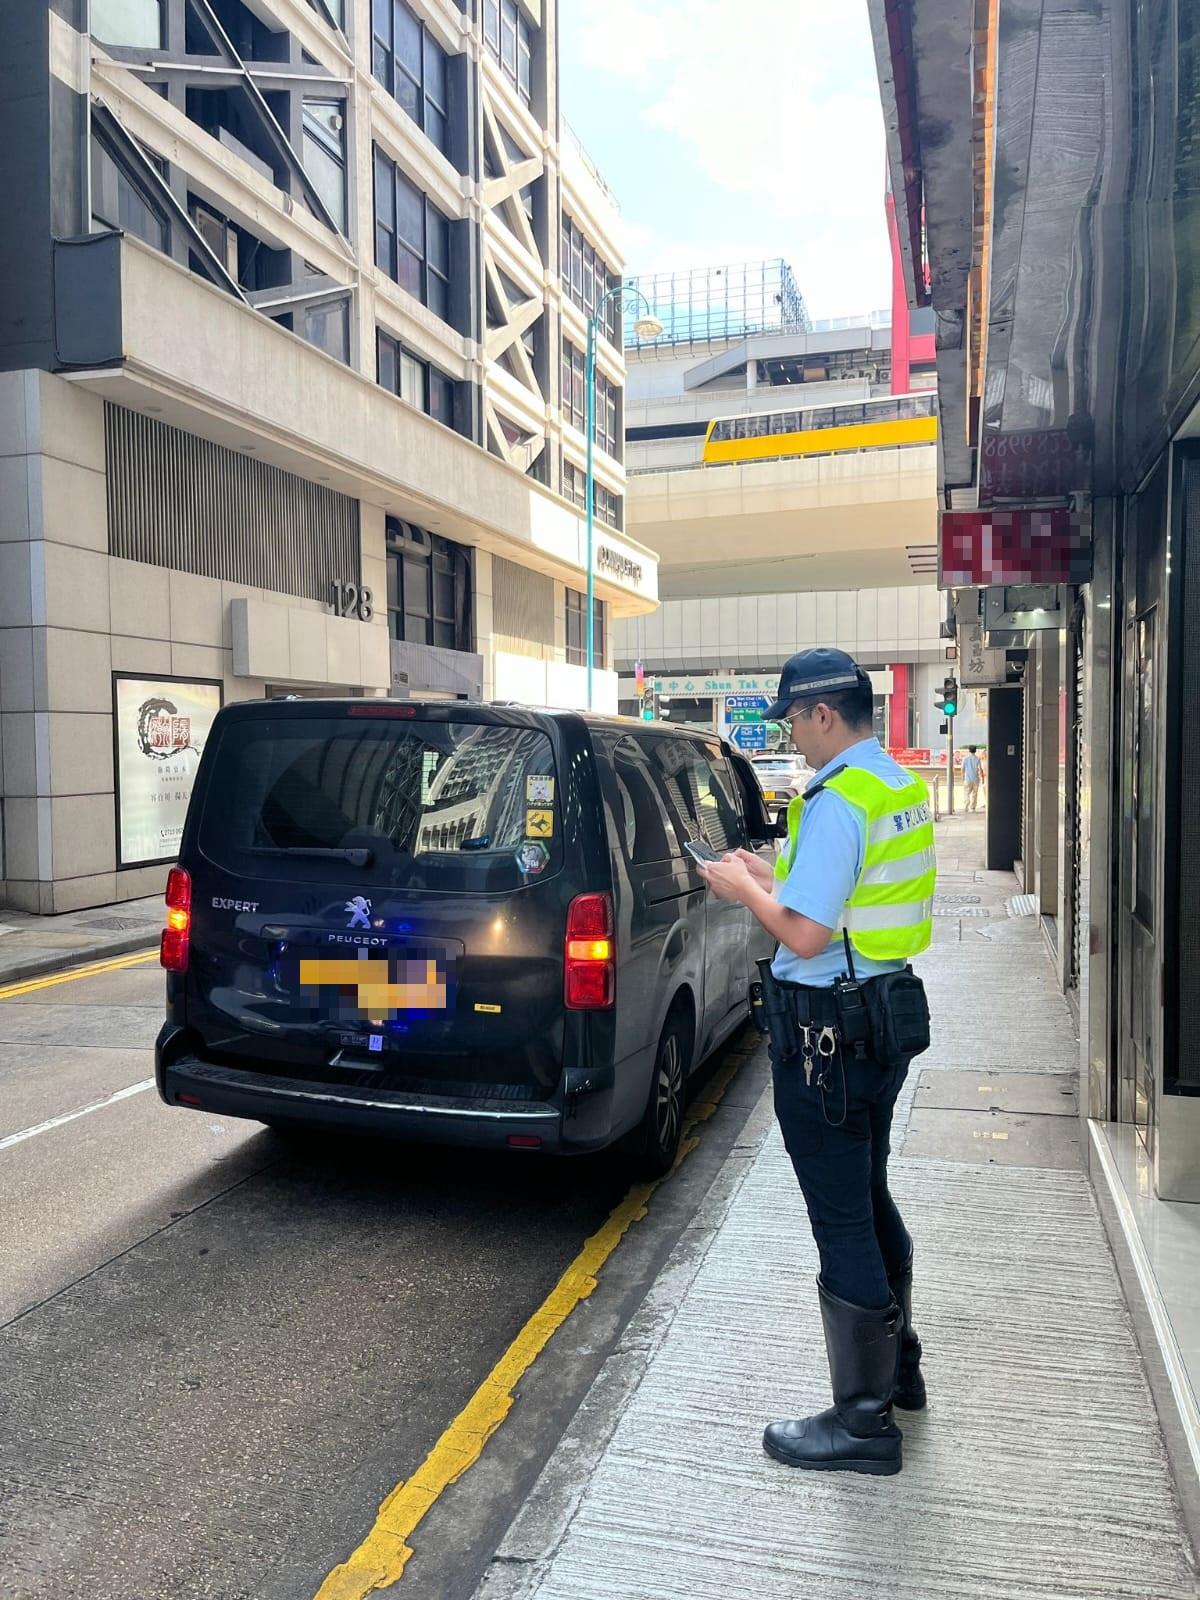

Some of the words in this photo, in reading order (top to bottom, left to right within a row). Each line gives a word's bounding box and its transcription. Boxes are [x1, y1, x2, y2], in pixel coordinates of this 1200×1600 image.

[334, 579, 373, 622] 128
[705, 680, 731, 689] Shun
[740, 679, 758, 688] Tak
[211, 897, 259, 912] EXPERT
[328, 934, 388, 946] PEUGEOT
